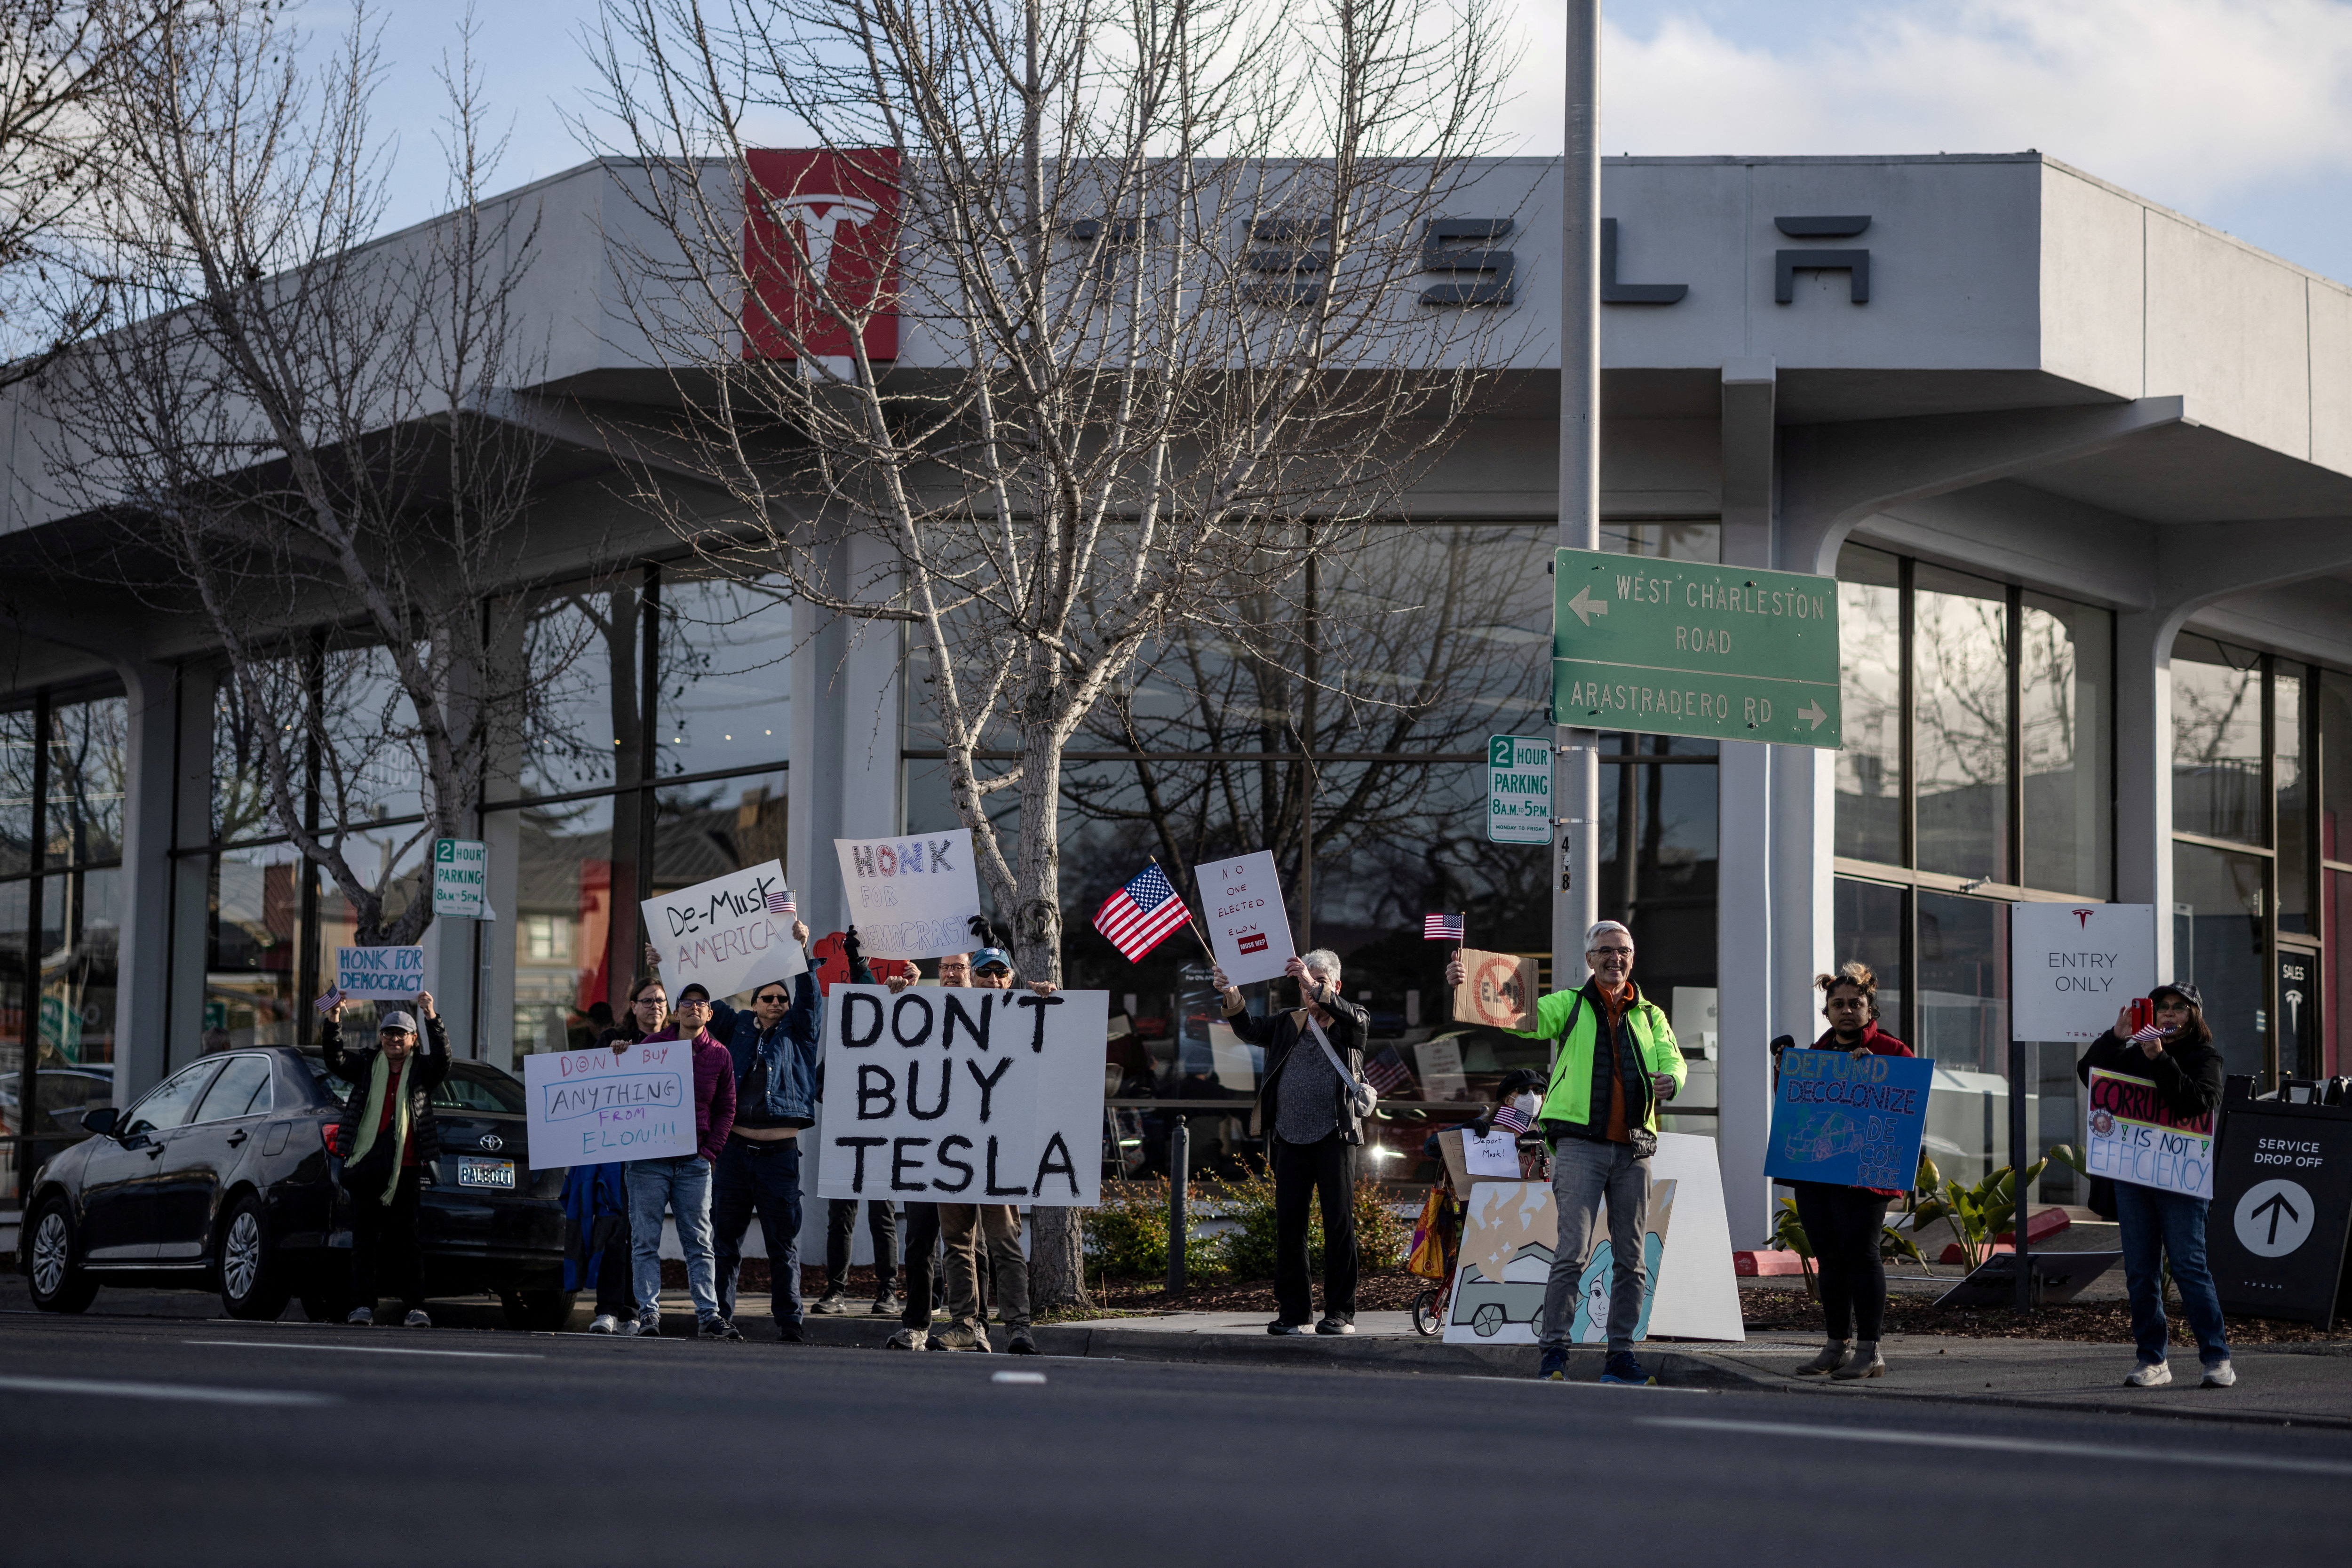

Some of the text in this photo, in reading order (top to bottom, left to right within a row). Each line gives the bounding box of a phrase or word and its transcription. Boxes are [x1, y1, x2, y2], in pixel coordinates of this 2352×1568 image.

[1062, 215, 1872, 305] TESLA
[1616, 574, 1824, 620] WEST CHARLESTON
[1676, 625, 1731, 654] ROAD
[1570, 681, 1772, 723] ARASTRADERO RD
[1495, 740, 1548, 765] 2 HOUR
[1494, 773, 1548, 795] PARKING
[1492, 798, 1518, 815] 8A.M.
[1525, 801, 1549, 817] 5P.M.
[440, 843, 482, 861] 2 HOUR
[852, 839, 956, 878] HONK
[438, 868, 481, 884] PARKING
[1222, 865, 1243, 880] NO
[860, 885, 898, 908] FOR
[1227, 884, 1247, 896] ONE
[1218, 899, 1264, 917] ELECTED
[857, 915, 974, 953] DEMOCRACY
[1228, 922, 1257, 936] ELON
[678, 918, 784, 974] AMERICA
[1240, 941, 1254, 950] MUSK
[341, 949, 422, 970] HONK FOR
[2049, 953, 2118, 968] ENTRY
[340, 972, 423, 991] DEMOCRACY
[2283, 964, 2304, 981] SALES
[2056, 976, 2114, 992] ONLY
[841, 990, 1065, 1054] DON'T
[643, 1047, 668, 1066] BUY
[1783, 1051, 1889, 1082] DEFUND
[1331, 1055, 1353, 1087] lululemon
[551, 1080, 675, 1114] ANYTHING
[856, 1056, 1015, 1126] BUY
[1786, 1079, 1917, 1115] DECOLONIZE
[599, 1107, 644, 1127] FROM
[2090, 1109, 2100, 1122] DON'T
[583, 1121, 675, 1154] ELON!!!
[1866, 1115, 1898, 1143] DE
[2094, 1120, 2115, 1138] SWASTICAR
[1473, 1135, 1502, 1149] Deport
[2134, 1127, 2153, 1147] IS
[2160, 1133, 2195, 1157] NOT
[2258, 1138, 2320, 1153] SERVICE
[1482, 1149, 1505, 1158] Musk!
[1860, 1144, 1903, 1168] COM
[2254, 1153, 2323, 1168] DROP OFF
[834, 1131, 1081, 1199] TESLA
[2090, 1138, 2210, 1192] EFFICIENCY
[1857, 1165, 1899, 1188] POSE
